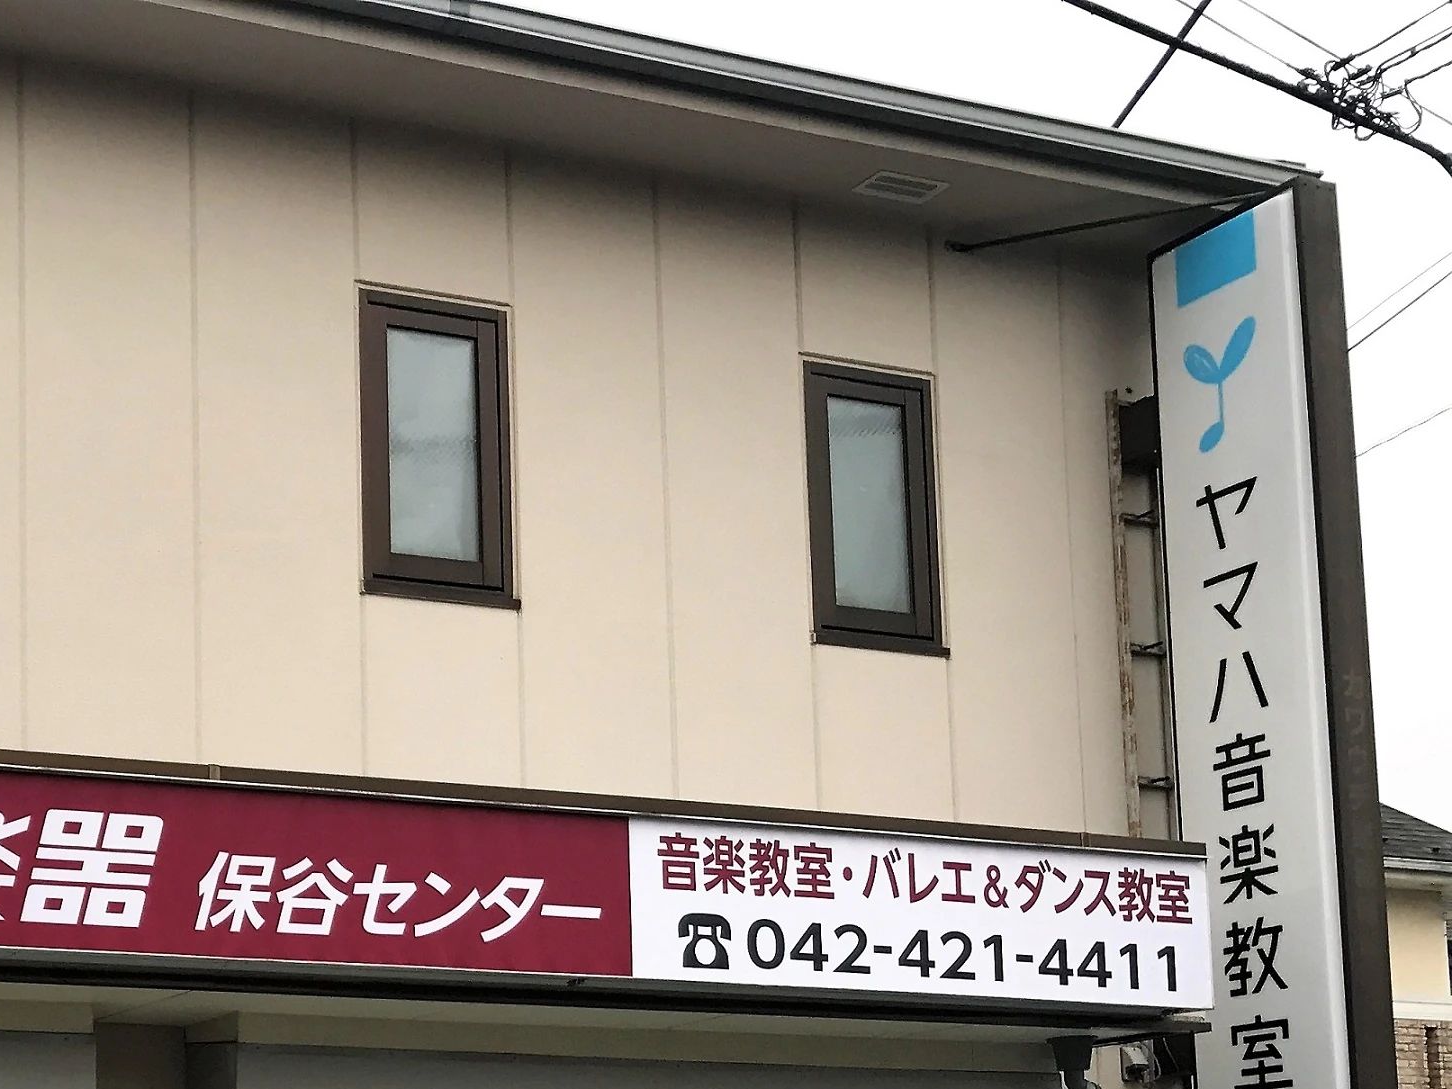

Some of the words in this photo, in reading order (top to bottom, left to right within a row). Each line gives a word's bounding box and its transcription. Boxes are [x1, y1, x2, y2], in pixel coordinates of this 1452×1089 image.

[194, 851, 602, 943] 保谷センター
[747, 918, 1178, 993] 042-421-4411
